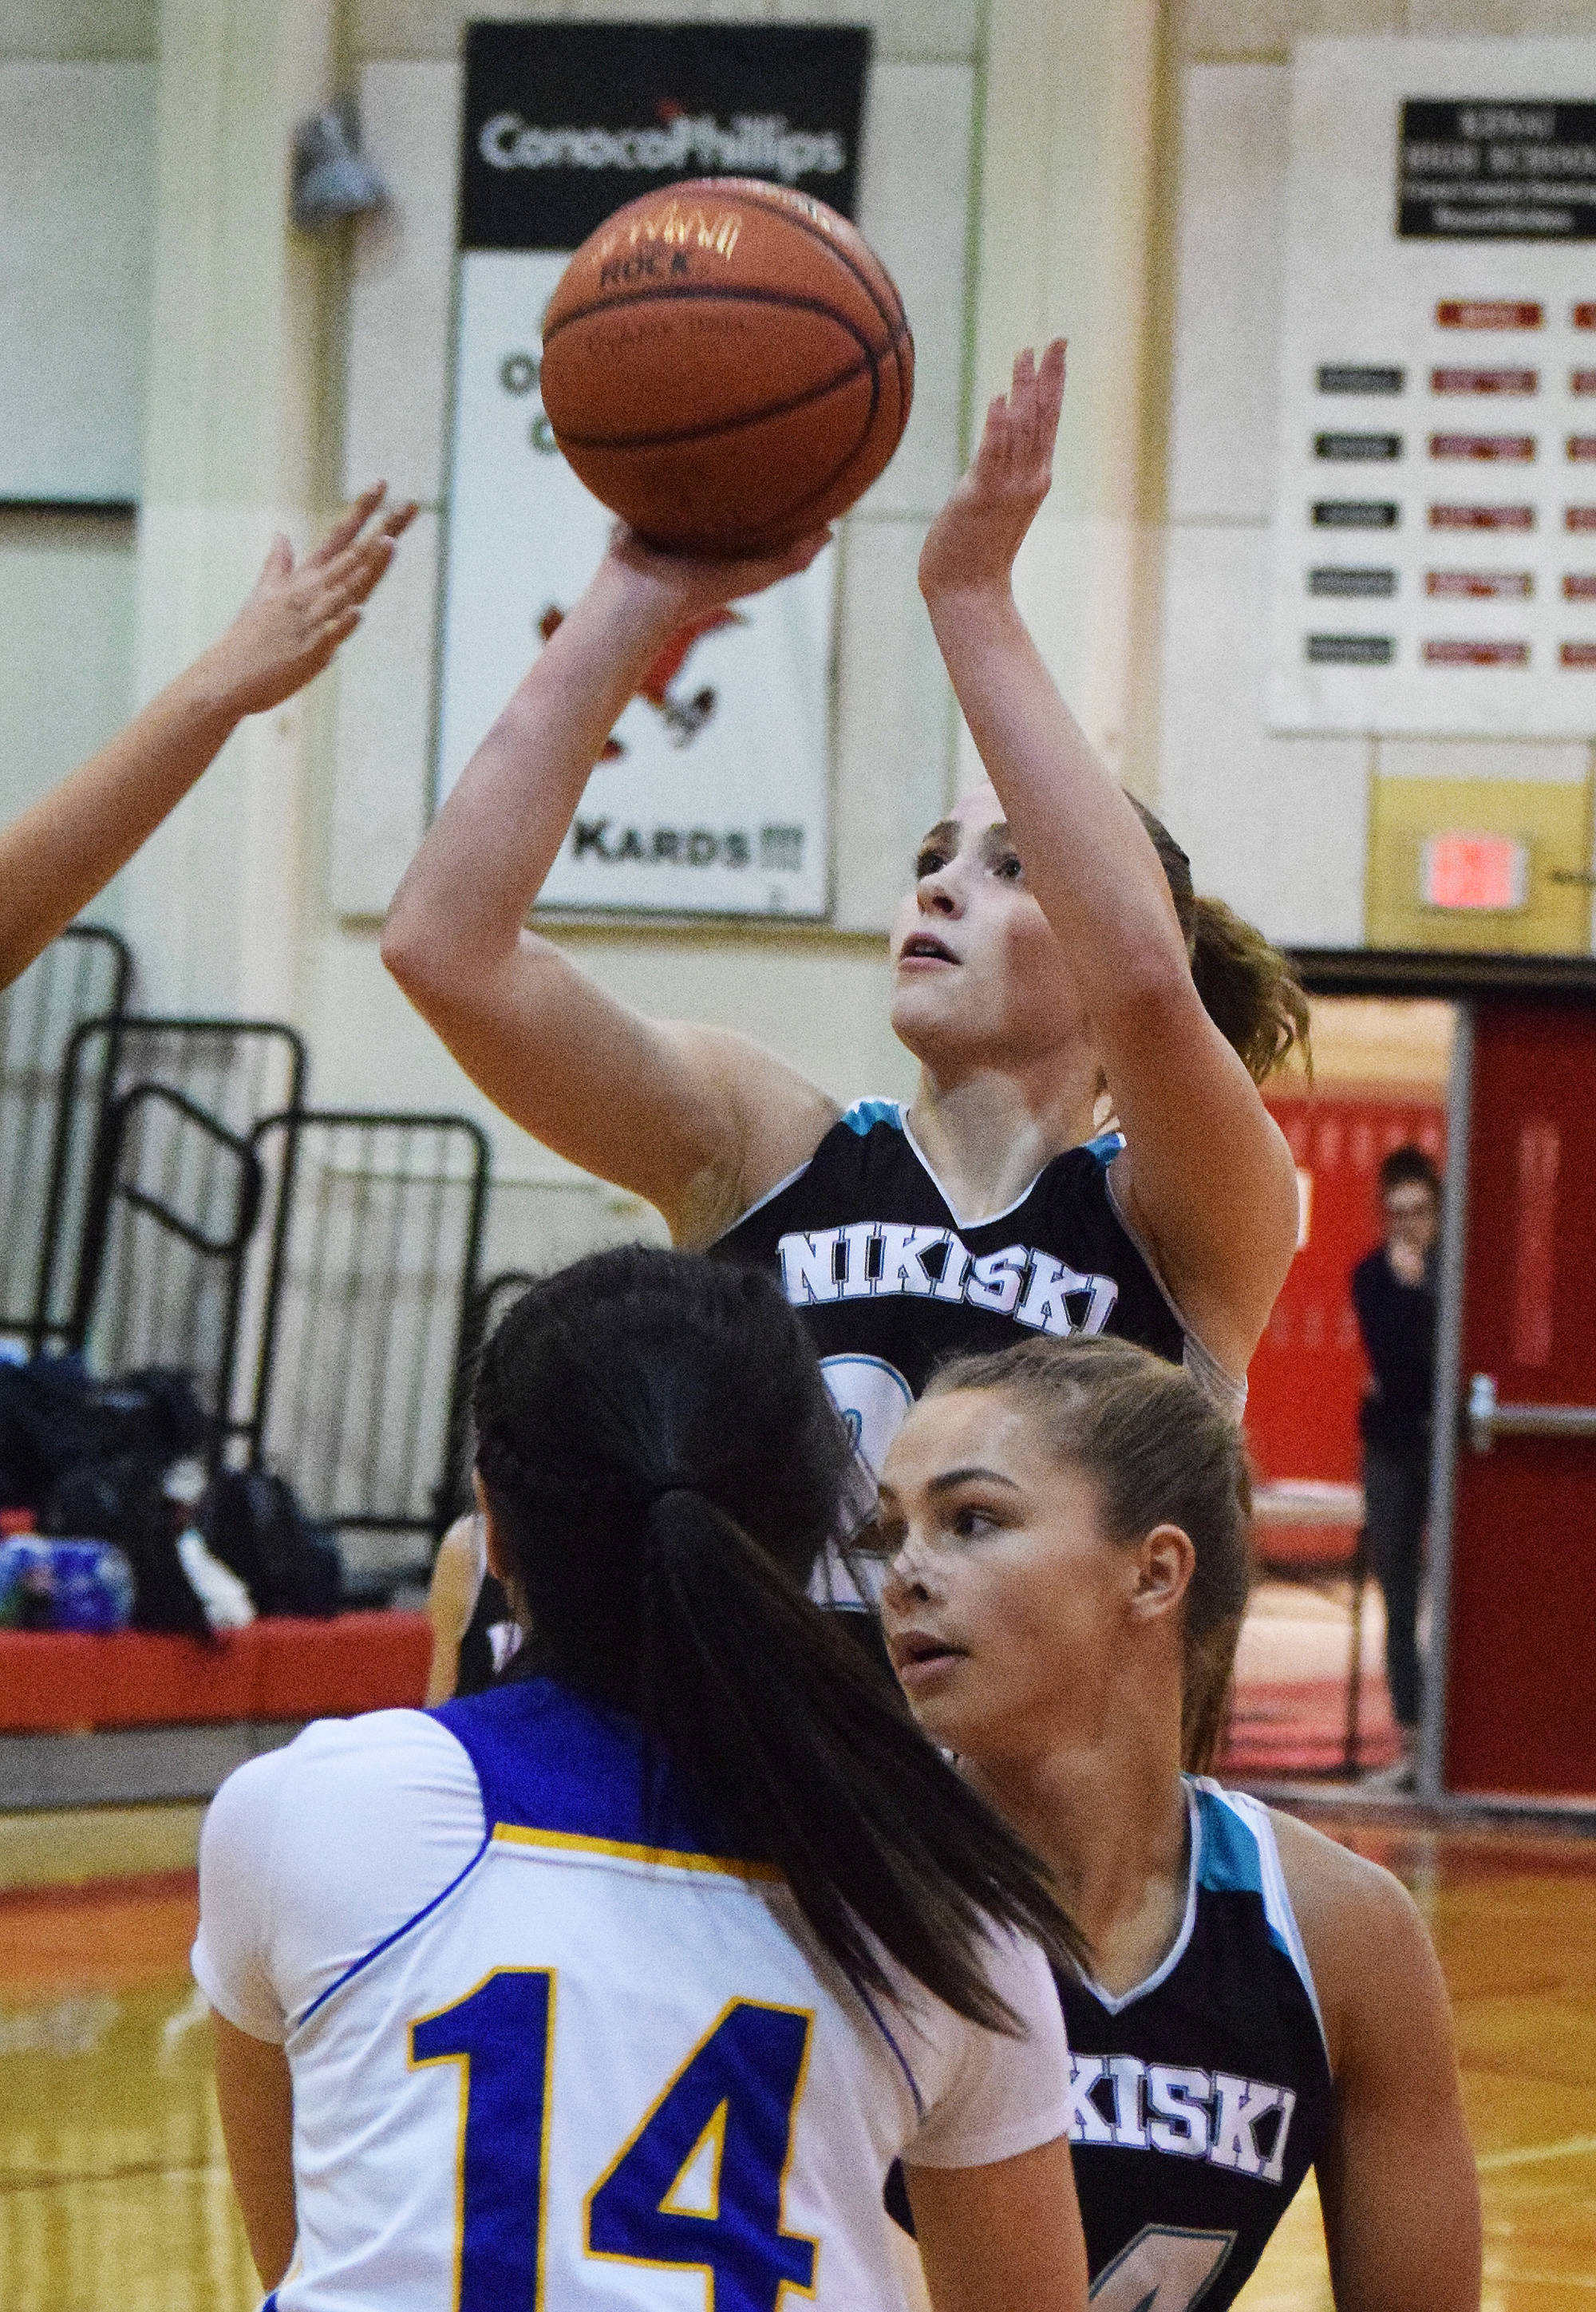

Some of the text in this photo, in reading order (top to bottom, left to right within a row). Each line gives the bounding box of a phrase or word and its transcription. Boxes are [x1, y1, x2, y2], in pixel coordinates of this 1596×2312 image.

[480, 113, 844, 180] ConocoPhillips
[776, 1221, 1119, 1338] NIKISKI
[406, 1965, 820, 2312] 14
